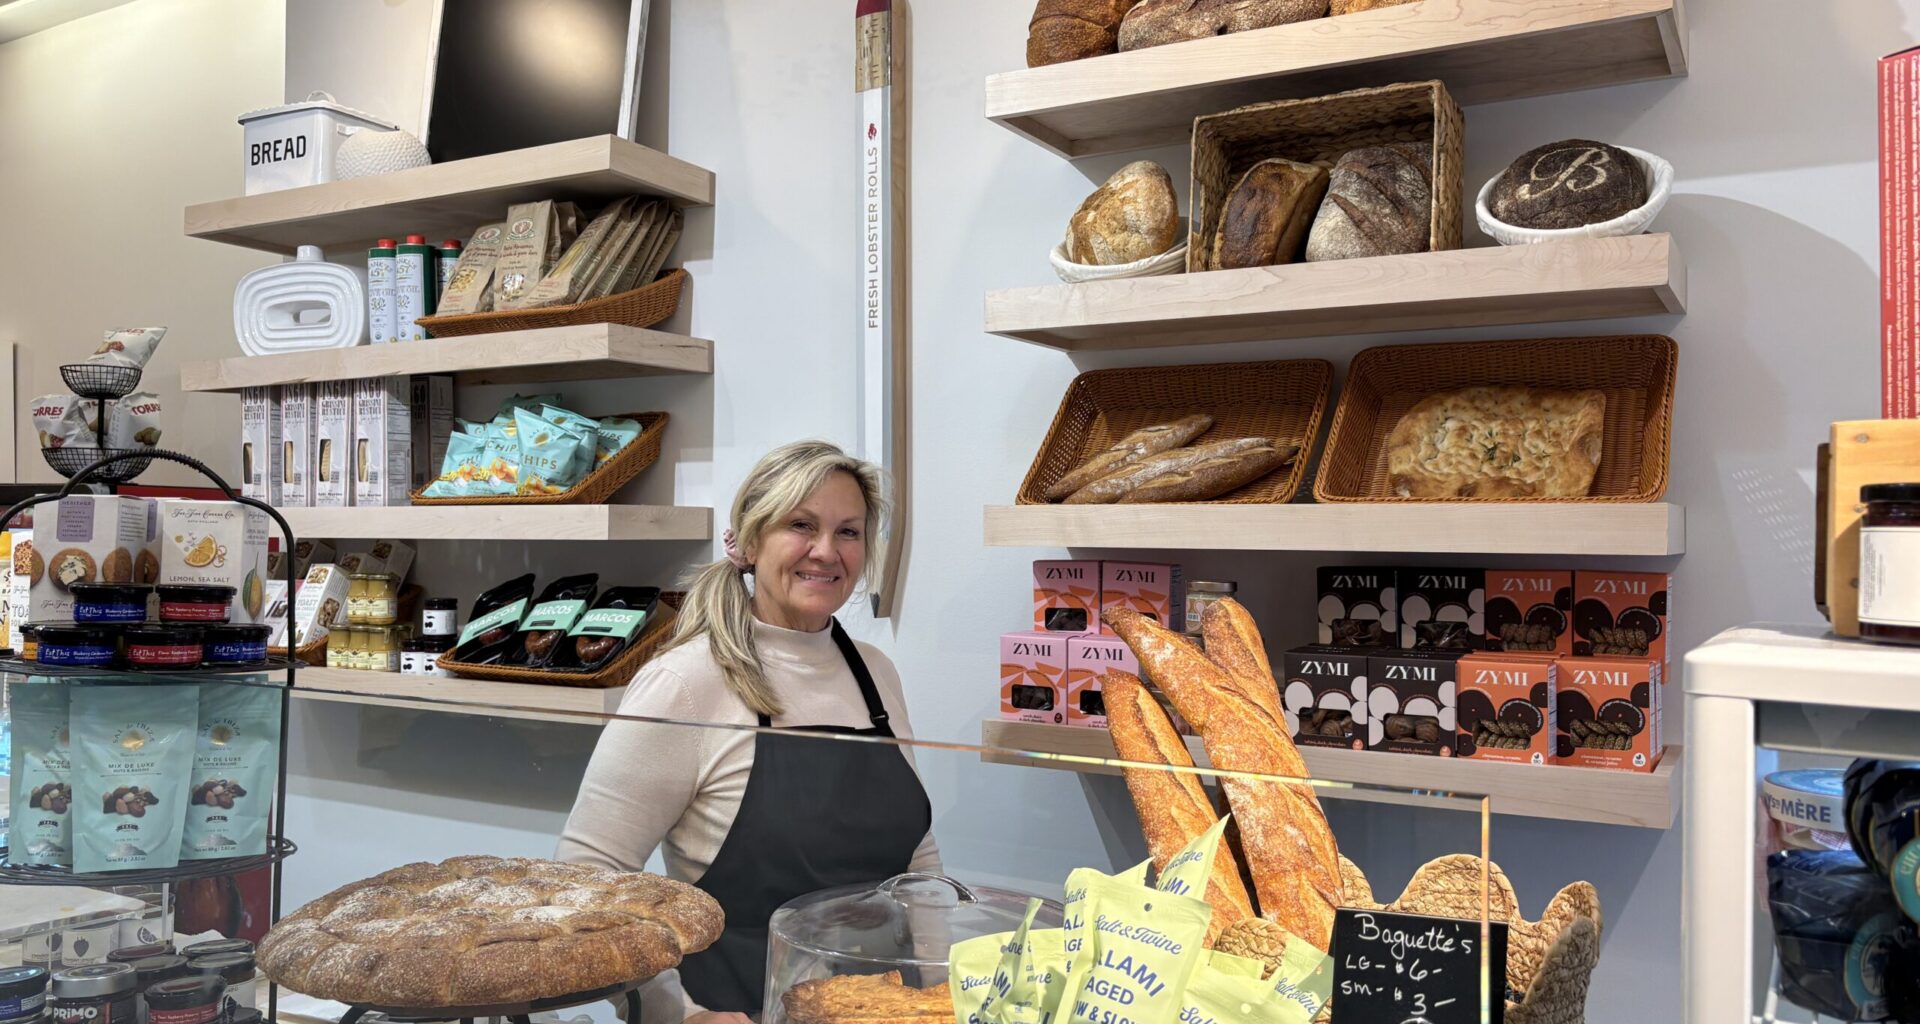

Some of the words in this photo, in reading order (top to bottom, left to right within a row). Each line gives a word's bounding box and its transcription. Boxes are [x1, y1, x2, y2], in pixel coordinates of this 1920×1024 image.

[251, 135, 306, 166] BREAD
[868, 147, 878, 198] ROLLS
[868, 202, 878, 273] LOBSTER
[868, 282, 878, 328] FRESH
[485, 440, 517, 453] CHIP
[1046, 567, 1083, 580] ZYMI
[1116, 570, 1155, 583] ZYMI
[1332, 575, 1378, 588] ZYMI
[1418, 576, 1467, 589] ZYMI
[1503, 578, 1552, 592] ZYMI
[1594, 580, 1648, 595] ZYMI
[469, 605, 517, 632] MARCOS
[533, 604, 574, 617] MARCOS
[582, 611, 633, 625] MARCOS
[1013, 643, 1051, 656] ZYMI
[1082, 647, 1123, 660] ZYMI
[1301, 660, 1349, 676] ZYMI
[1385, 665, 1436, 681] ZYMI
[1475, 670, 1528, 686] ZYMI
[1573, 670, 1629, 687] ZYMI
[1781, 798, 1831, 823] MÈRE
[1094, 915, 1119, 934] Salt
[1119, 924, 1131, 937] &
[1132, 927, 1182, 955] Twine
[1354, 914, 1473, 960] Baguette's
[1085, 976, 1134, 1005] AGED
